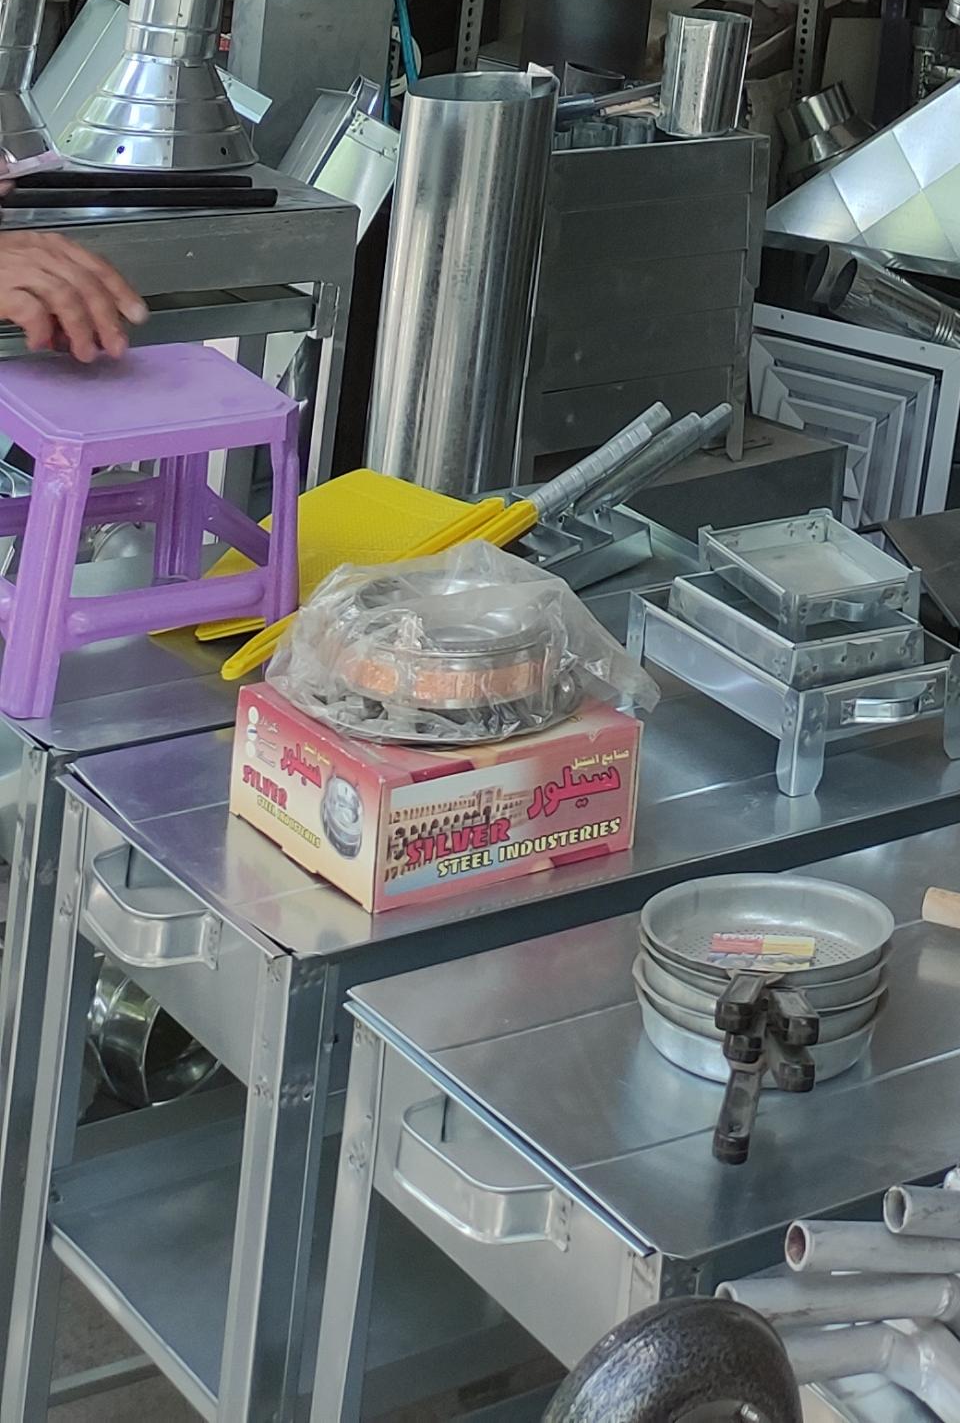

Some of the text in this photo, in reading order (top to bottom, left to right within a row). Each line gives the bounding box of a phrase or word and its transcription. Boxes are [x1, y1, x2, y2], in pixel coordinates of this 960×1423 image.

[242, 764, 288, 811] SILVER
[526, 765, 622, 821] سیلور
[405, 817, 512, 866] SILVER
[437, 816, 622, 878] STEEL INDUSTERIES
